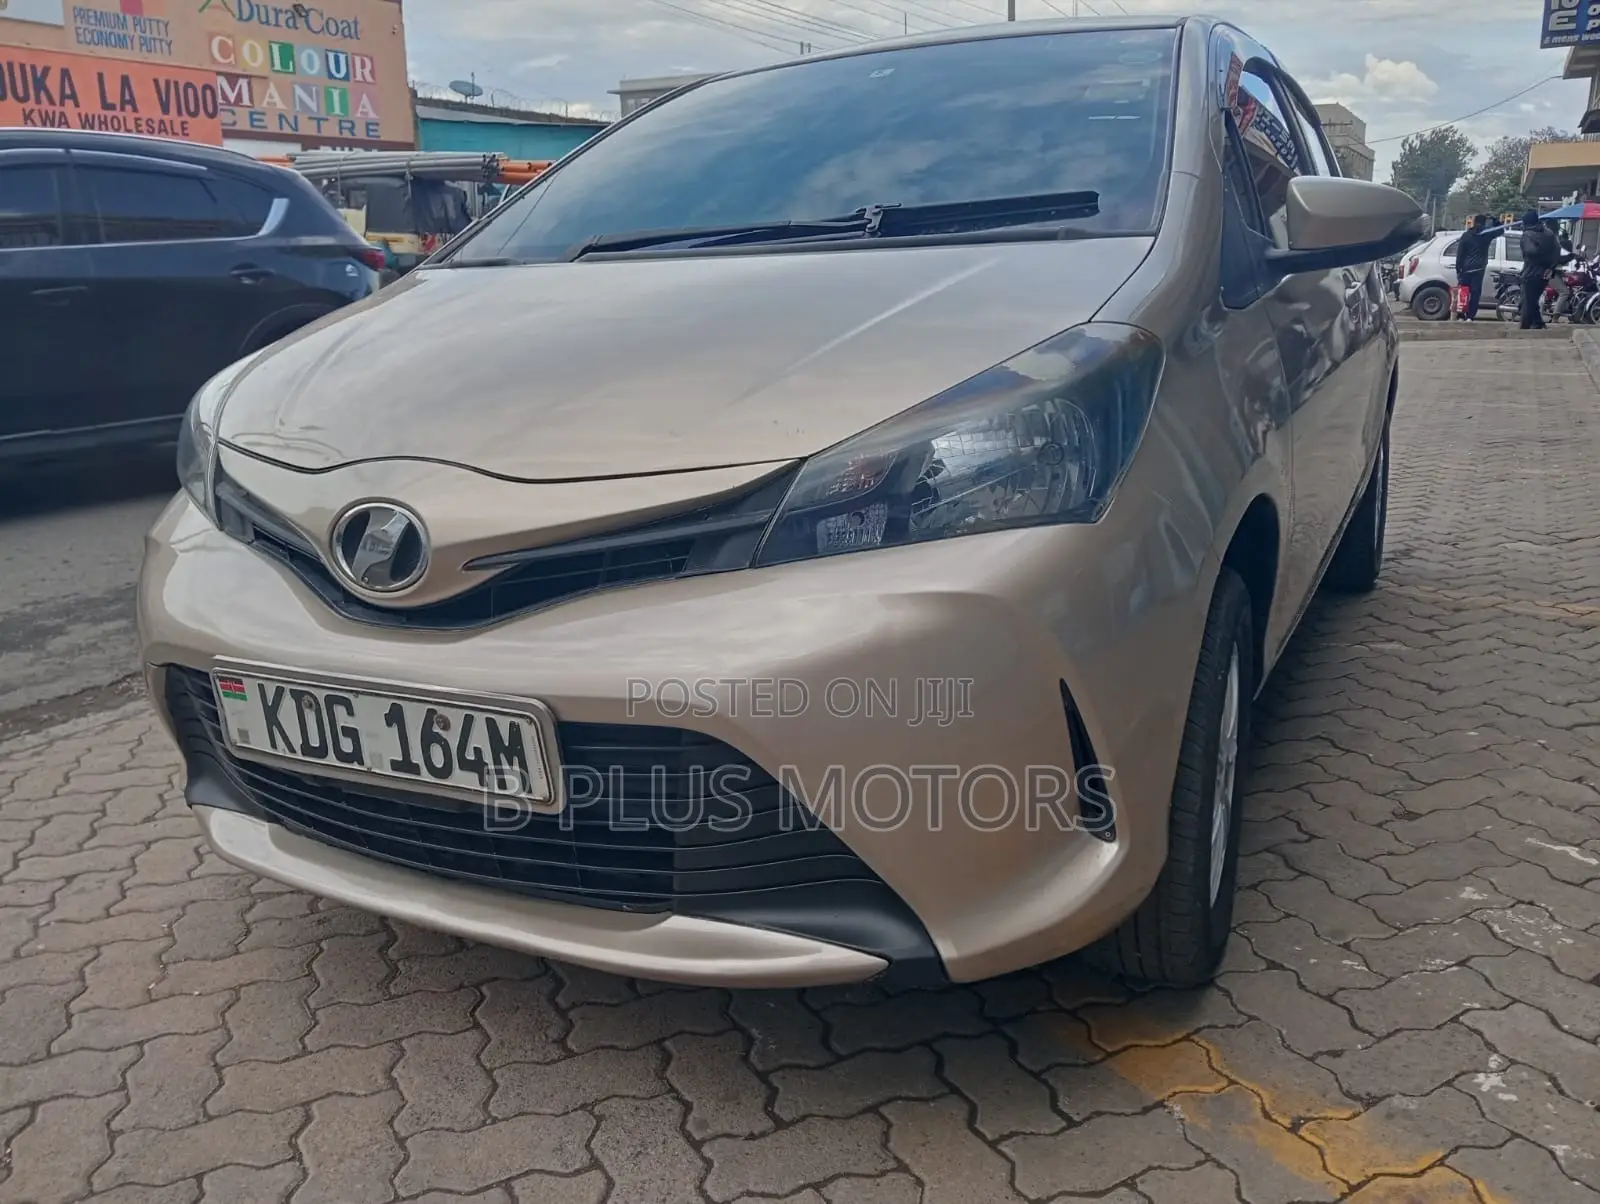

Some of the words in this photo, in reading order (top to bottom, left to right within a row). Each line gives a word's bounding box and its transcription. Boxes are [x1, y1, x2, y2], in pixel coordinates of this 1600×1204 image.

[73, 6, 129, 31] PREMIUM
[132, 15, 170, 38] PUTTY
[75, 26, 135, 51] ECONOMY
[139, 35, 173, 56] PUTTY
[210, 35, 376, 84] COLOUR
[97, 71, 139, 113] LA
[216, 75, 380, 119] MANIA
[22, 107, 71, 129] KWA
[78, 111, 191, 137] WHOLESALE
[257, 682, 365, 767] KDG
[383, 701, 534, 794] 164M
